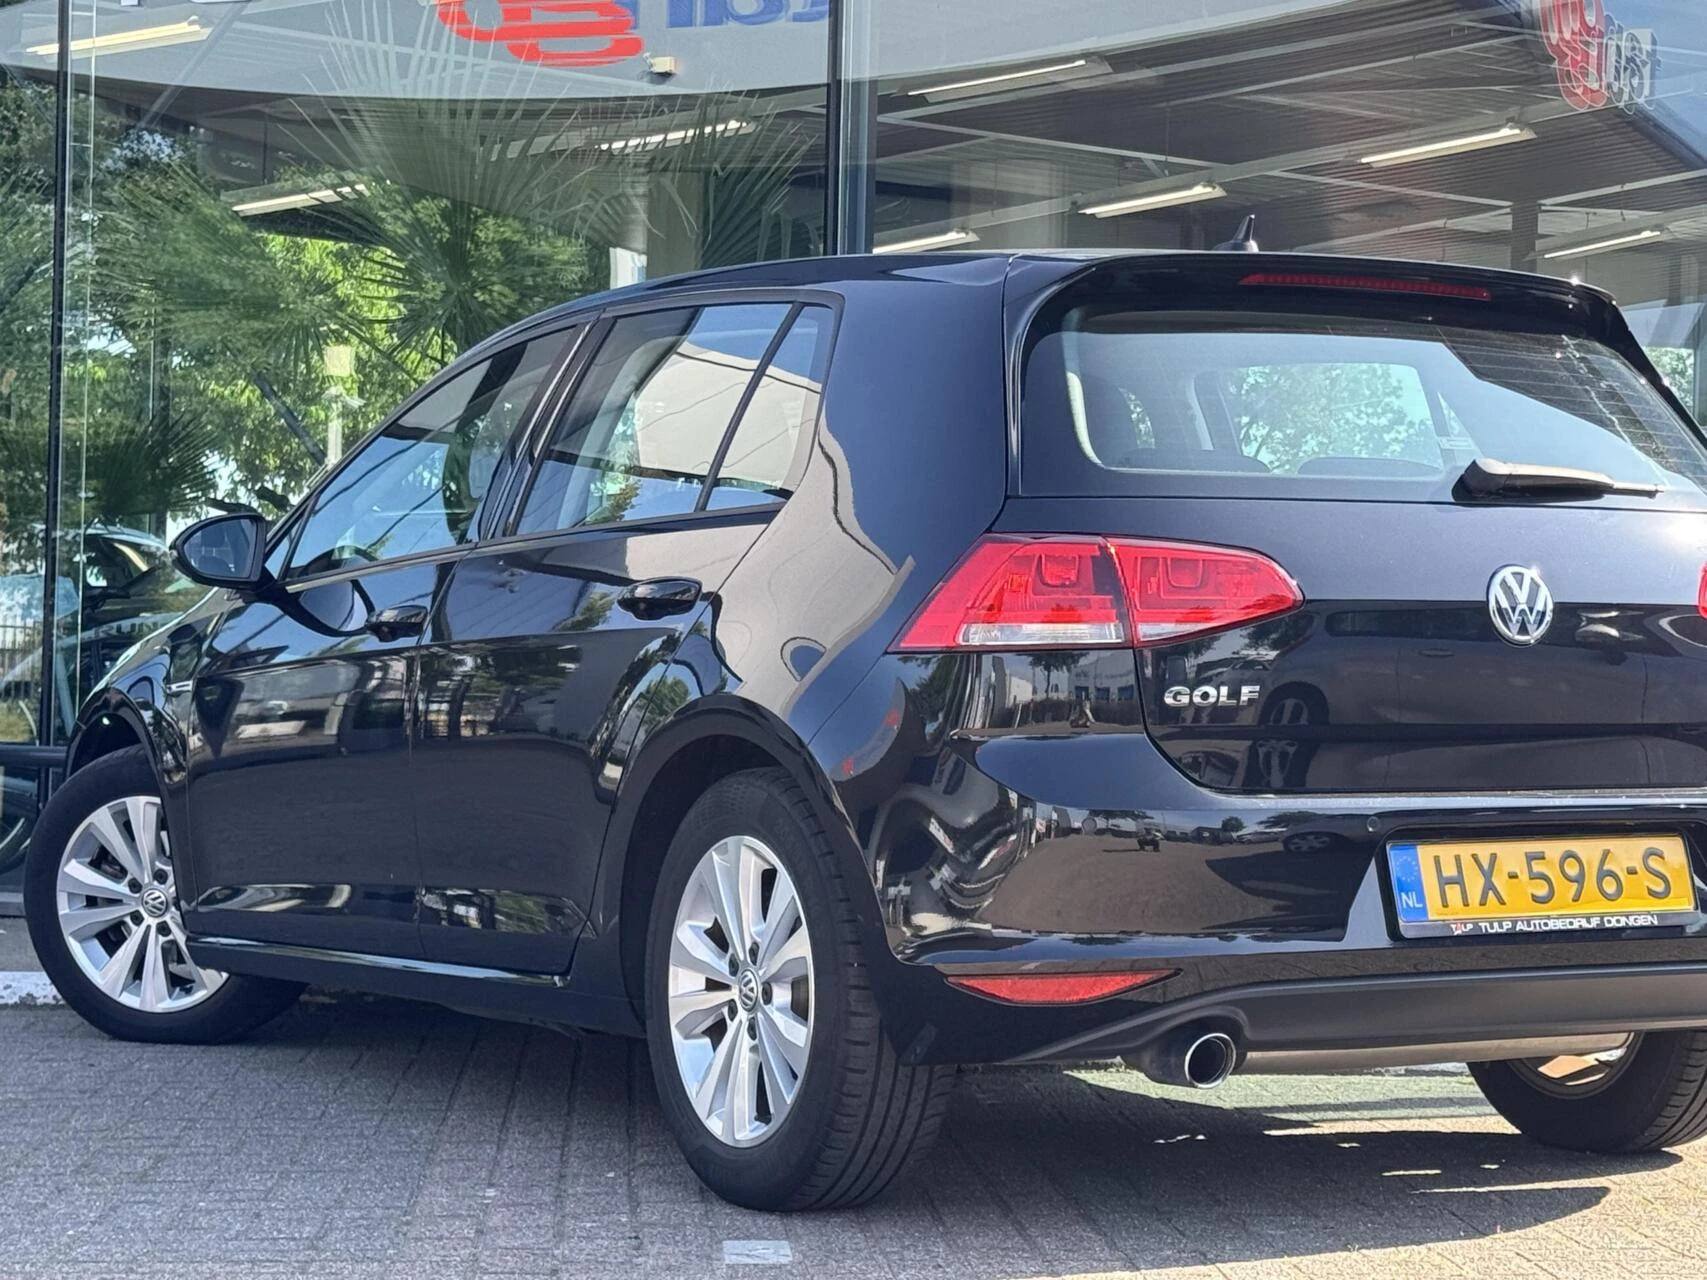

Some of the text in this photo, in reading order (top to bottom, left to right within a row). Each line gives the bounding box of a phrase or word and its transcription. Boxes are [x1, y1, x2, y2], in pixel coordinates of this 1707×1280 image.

[1163, 685, 1261, 708] GOLF
[1433, 846, 1672, 909] HX-596-S
[1401, 891, 1424, 909] NL
[1478, 921, 1513, 934] TULP
[1515, 917, 1601, 932] AUTOBEDRIJF
[1603, 914, 1659, 928] DONGEN
